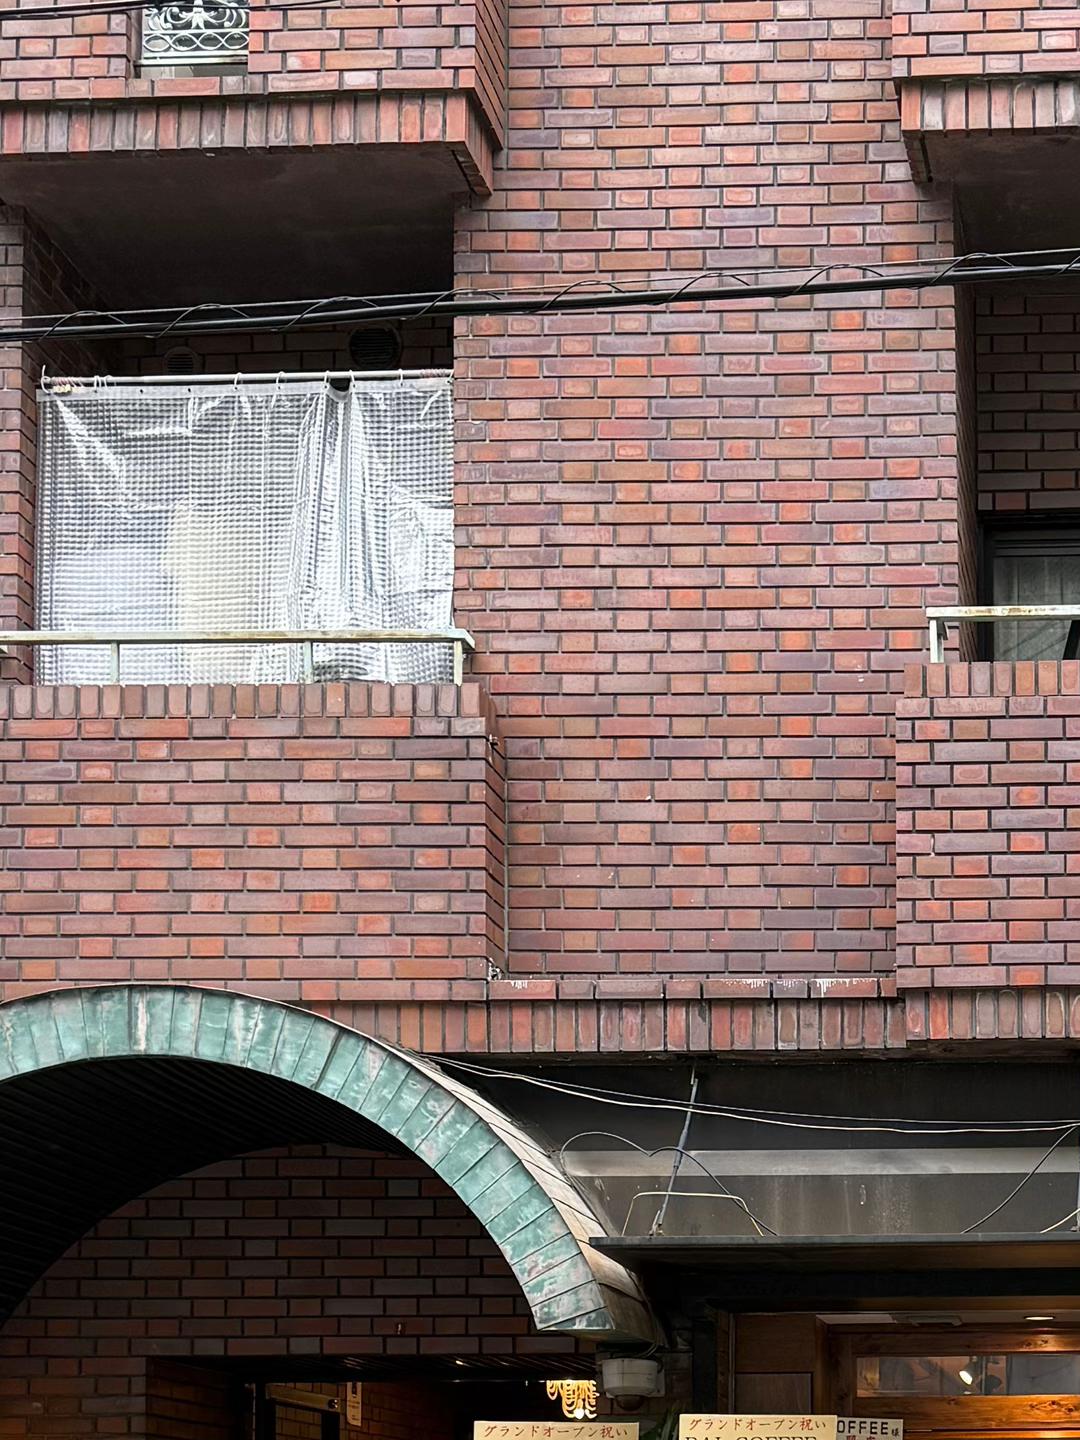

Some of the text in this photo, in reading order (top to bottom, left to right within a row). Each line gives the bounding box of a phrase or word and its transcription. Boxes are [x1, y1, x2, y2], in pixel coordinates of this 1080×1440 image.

[689, 1417, 826, 1431] グランドオープン祝い
[837, 1420, 889, 1435] OFFEE
[484, 1425, 628, 1438] グランドオープン祝い
